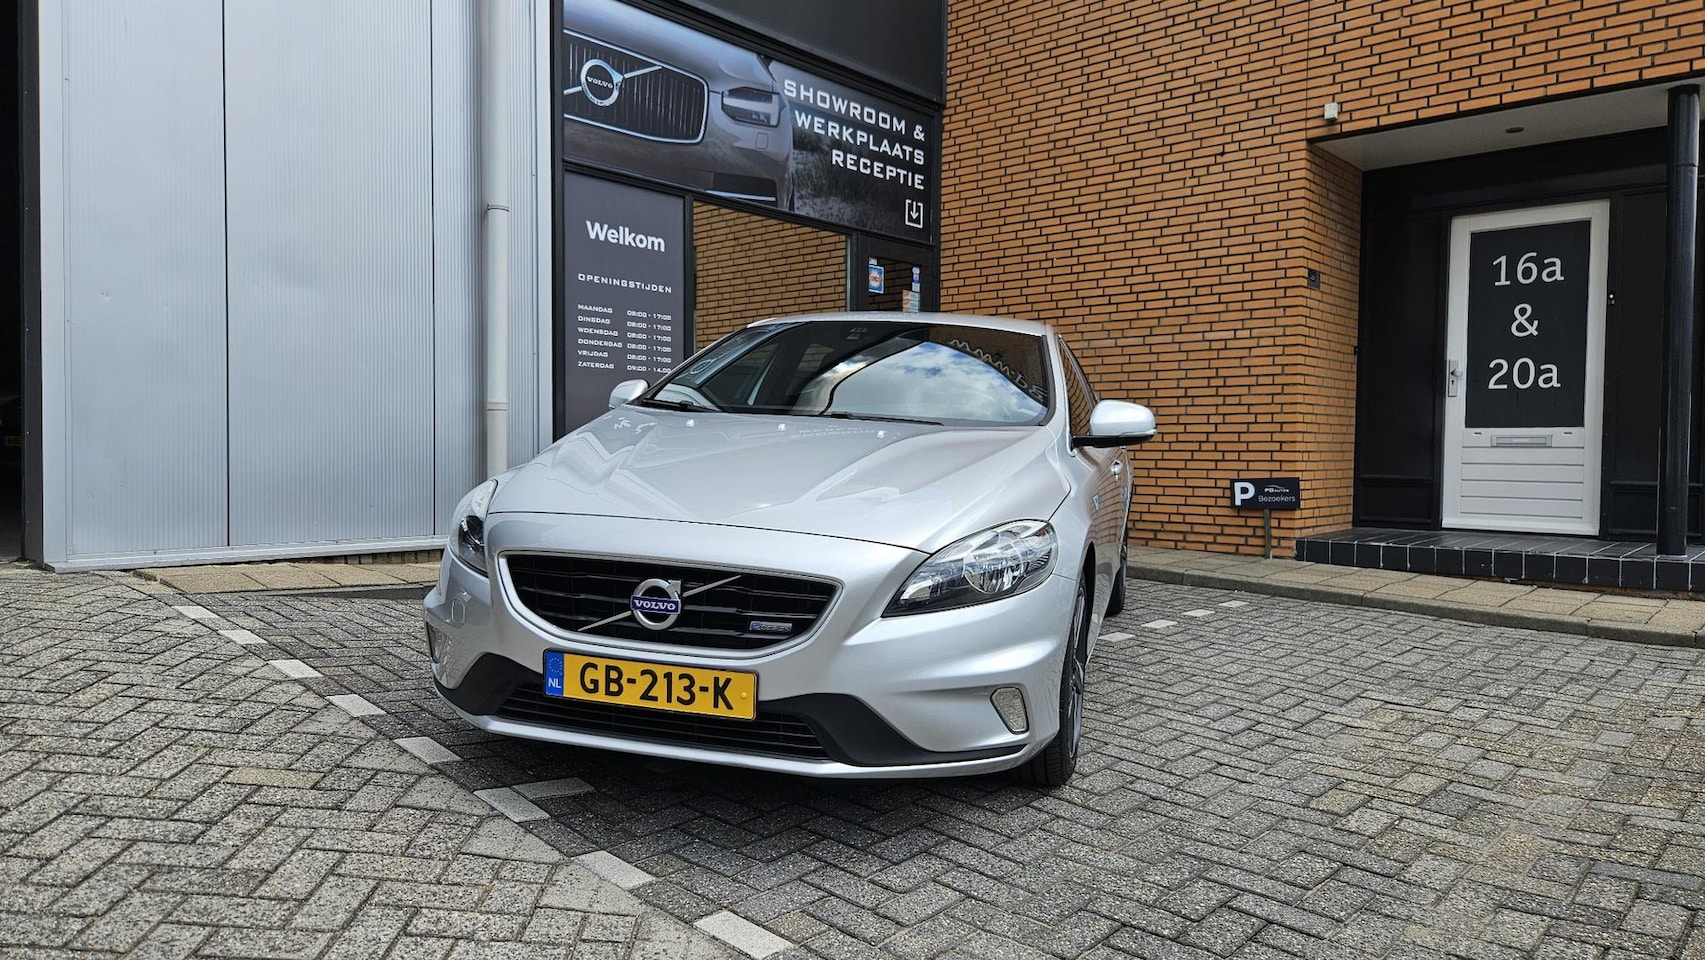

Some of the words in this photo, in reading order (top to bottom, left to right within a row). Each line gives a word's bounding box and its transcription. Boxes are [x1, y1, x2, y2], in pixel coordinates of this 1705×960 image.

[586, 76, 614, 89] VOLVO
[784, 79, 906, 135] SHOWROOM
[913, 124, 926, 142] &
[795, 110, 925, 166] WERKPLAATS
[832, 149, 925, 190] RECEPTIE
[586, 220, 665, 252] Welkom
[1492, 252, 1564, 286] 16a
[578, 273, 672, 293] OPENINGSTIJDEN
[578, 304, 613, 313] MAANDAG
[653, 313, 672, 321] 17:00
[578, 315, 611, 324] DINSDAG
[1511, 303, 1539, 337] &
[578, 327, 619, 336] WOENSDAG
[653, 334, 672, 342] 17:00
[578, 338, 623, 348] DONDERDAG
[578, 350, 609, 358] VRIJDAG
[578, 361, 615, 369] ZATERDAG
[1488, 357, 1561, 390] 20a
[1234, 482, 1255, 506] P
[1258, 494, 1296, 502] Bezoekers
[634, 599, 676, 611] VOLVO
[548, 677, 561, 689] NL
[579, 662, 734, 711] GB-213-K
